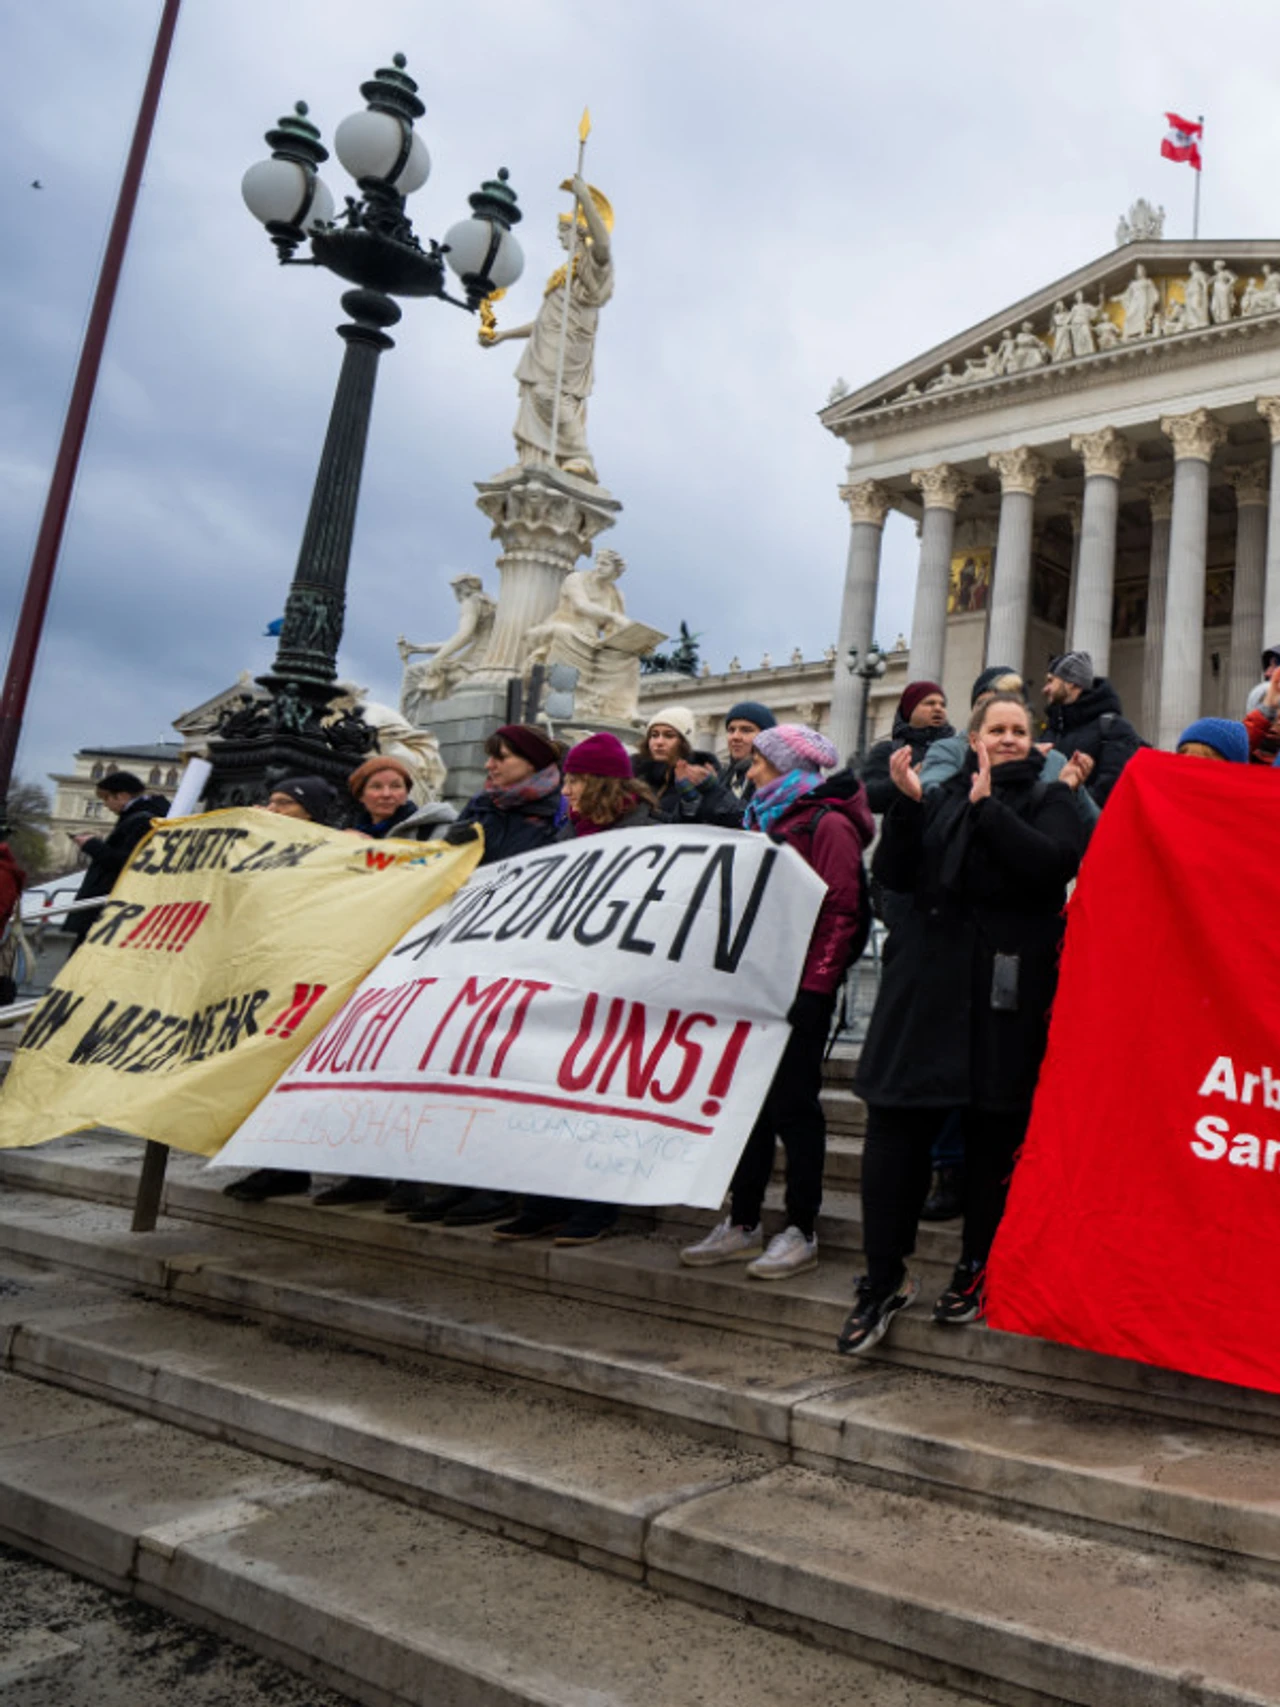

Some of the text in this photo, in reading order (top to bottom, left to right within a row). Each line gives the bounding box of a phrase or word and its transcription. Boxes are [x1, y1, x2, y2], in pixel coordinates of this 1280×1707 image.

[288, 975, 752, 1117] NICHT MIT UNS!
